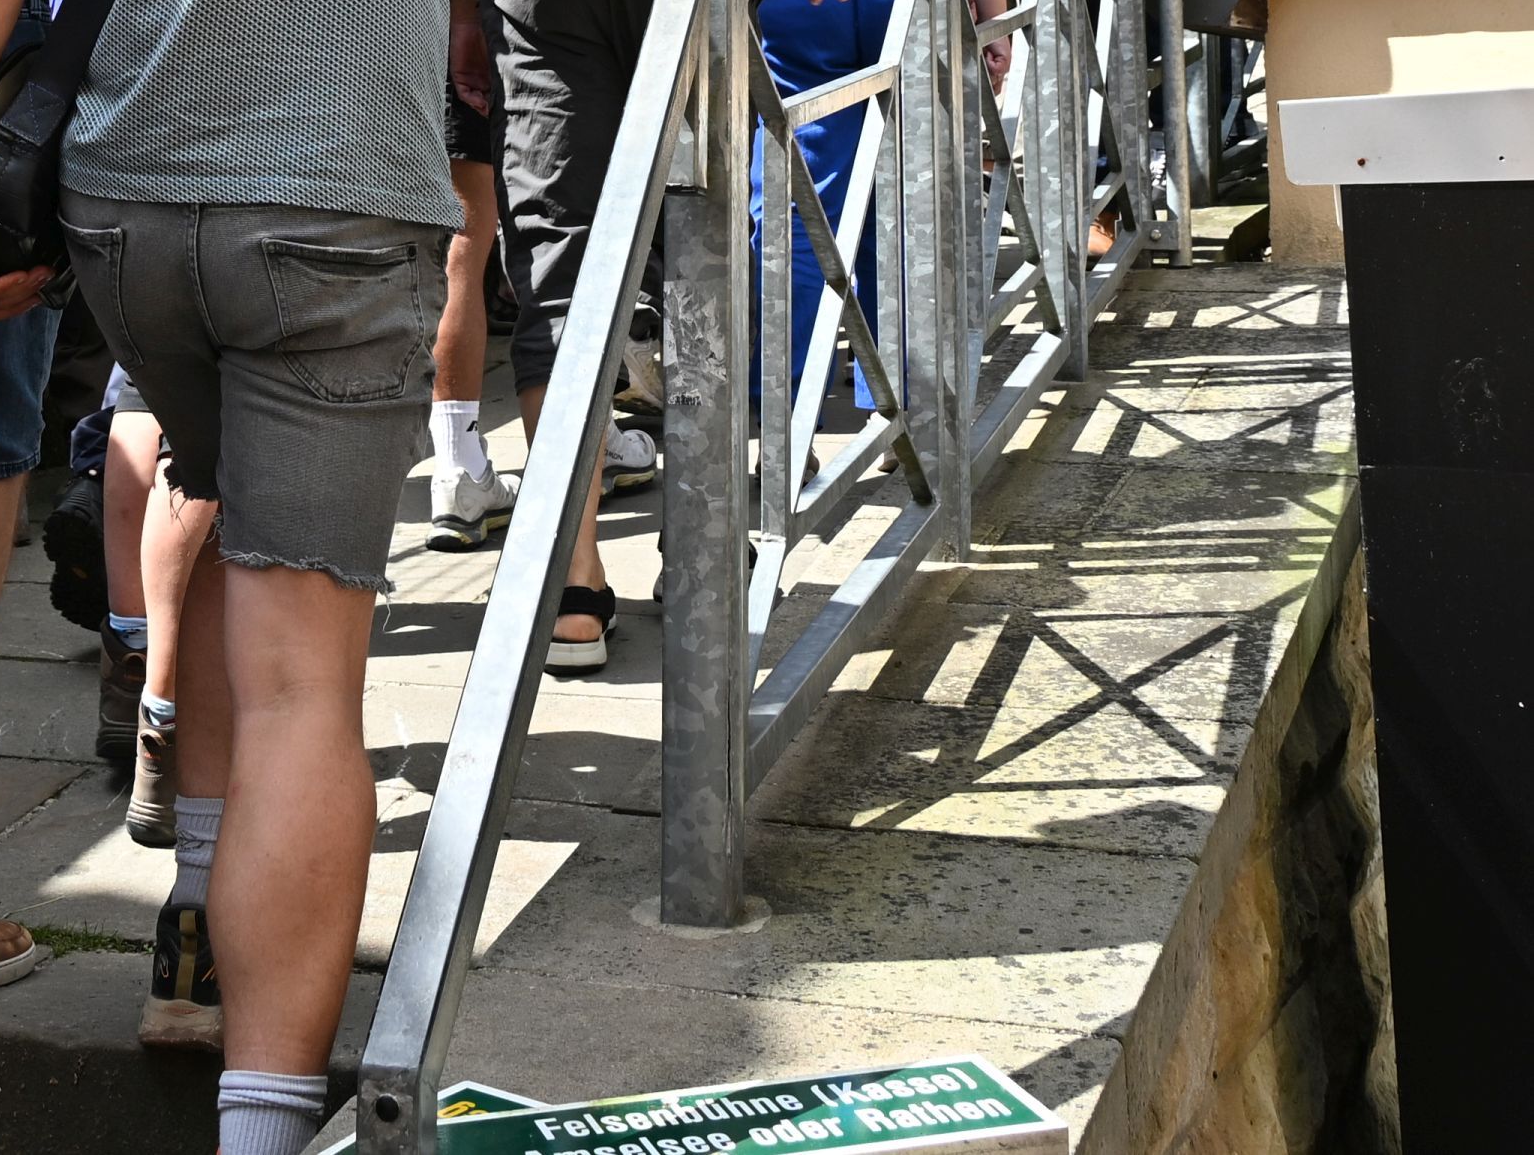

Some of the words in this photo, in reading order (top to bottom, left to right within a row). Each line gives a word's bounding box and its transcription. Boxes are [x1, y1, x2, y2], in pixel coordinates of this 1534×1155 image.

[534, 1094, 804, 1141] Felsenbühne
[810, 1066, 978, 1107] (Kasse)
[748, 1115, 844, 1146] oder
[854, 1097, 1013, 1133] Rathen
